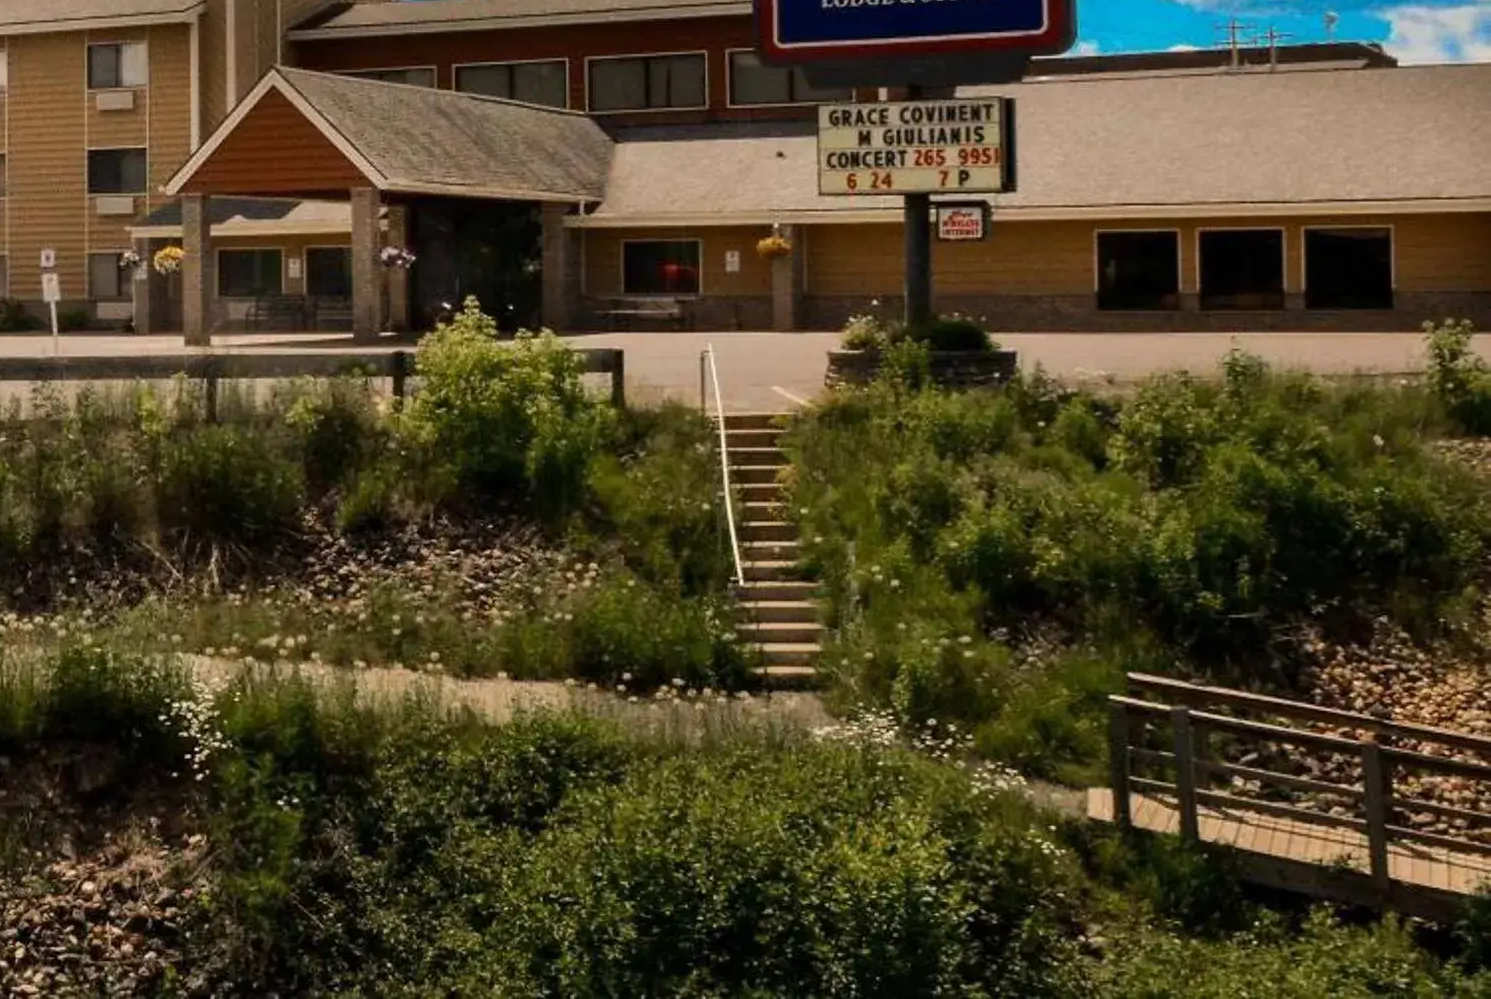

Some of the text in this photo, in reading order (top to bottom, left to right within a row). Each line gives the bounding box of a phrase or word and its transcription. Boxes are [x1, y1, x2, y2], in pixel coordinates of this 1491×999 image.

[829, 108, 889, 126] GRACE
[826, 149, 908, 169] CONCERT
[913, 149, 946, 167] 265
[846, 169, 970, 190] 6 24 7 P
